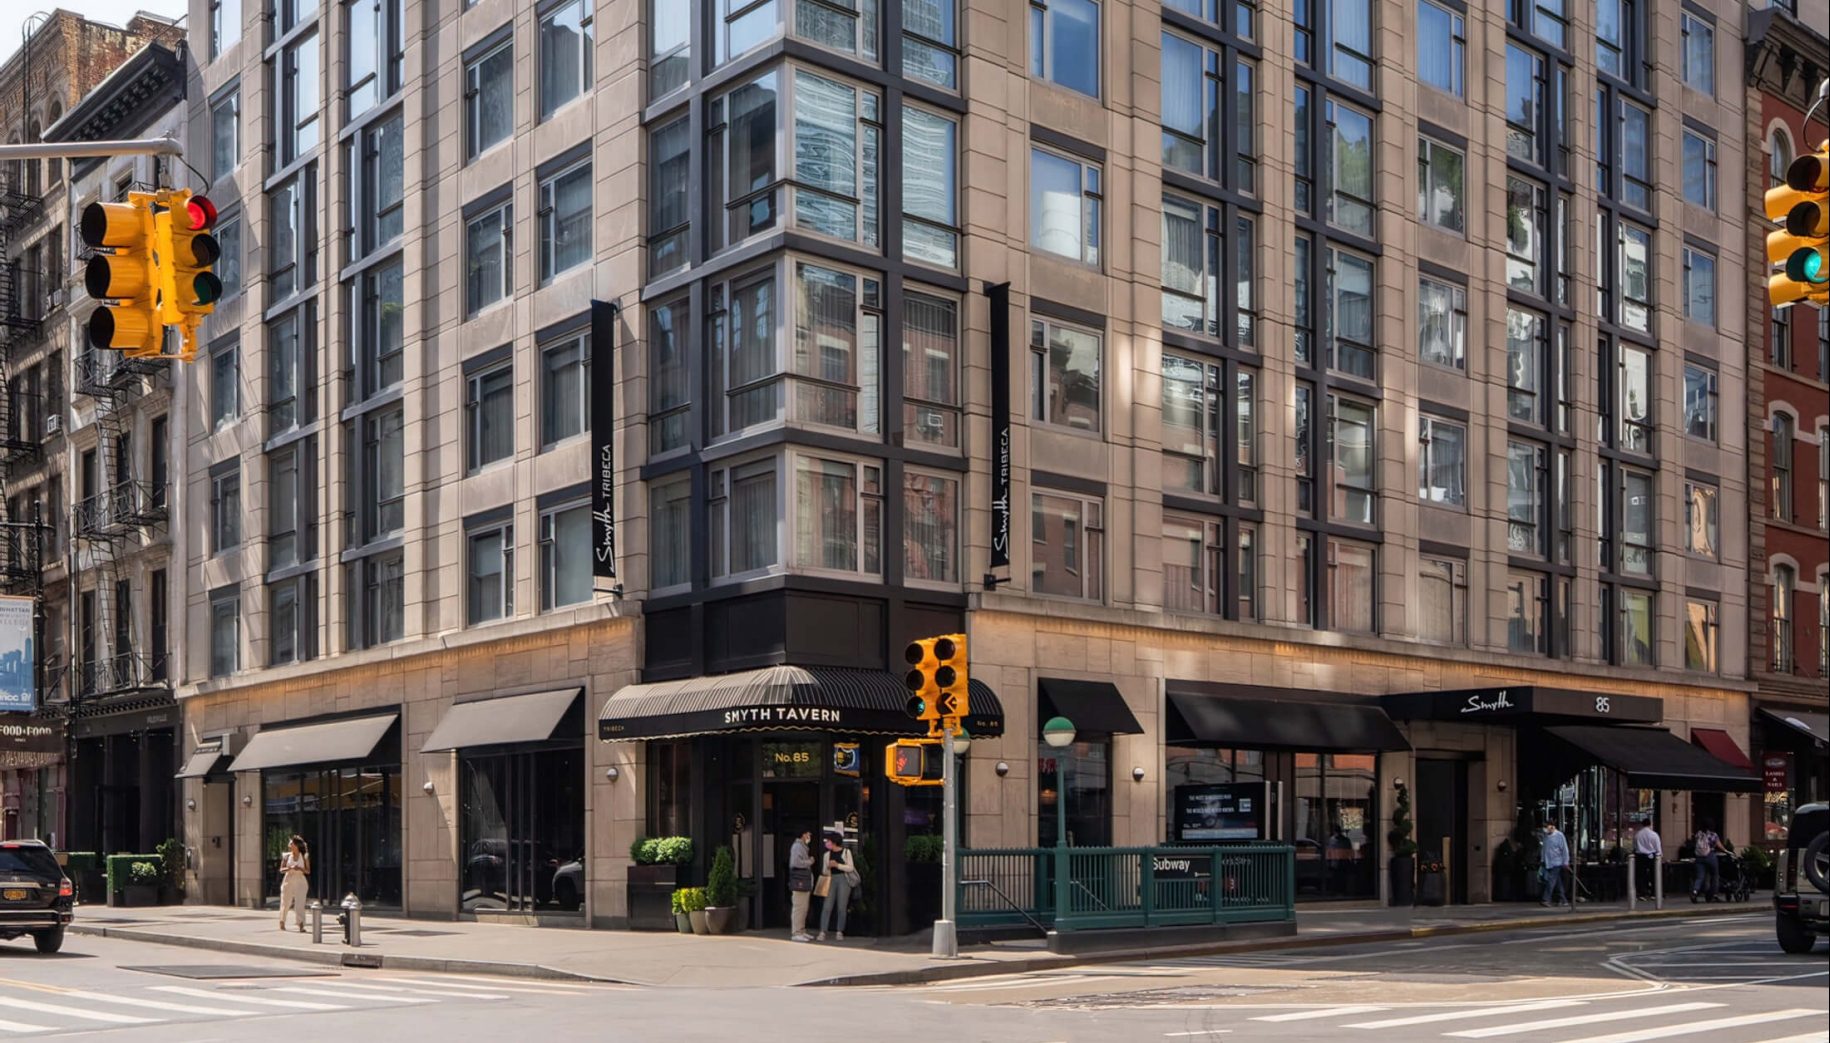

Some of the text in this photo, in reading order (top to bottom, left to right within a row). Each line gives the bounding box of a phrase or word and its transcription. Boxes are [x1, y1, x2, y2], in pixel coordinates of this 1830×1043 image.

[592, 444, 614, 573] Smyth TRIBECA
[992, 488, 1008, 559] Smyth
[1460, 690, 1514, 713] Smyth
[1595, 696, 1610, 713] 85
[724, 707, 841, 723] SMYTH TAVERN
[775, 752, 809, 762] No. 85
[1153, 856, 1190, 873] Subway
